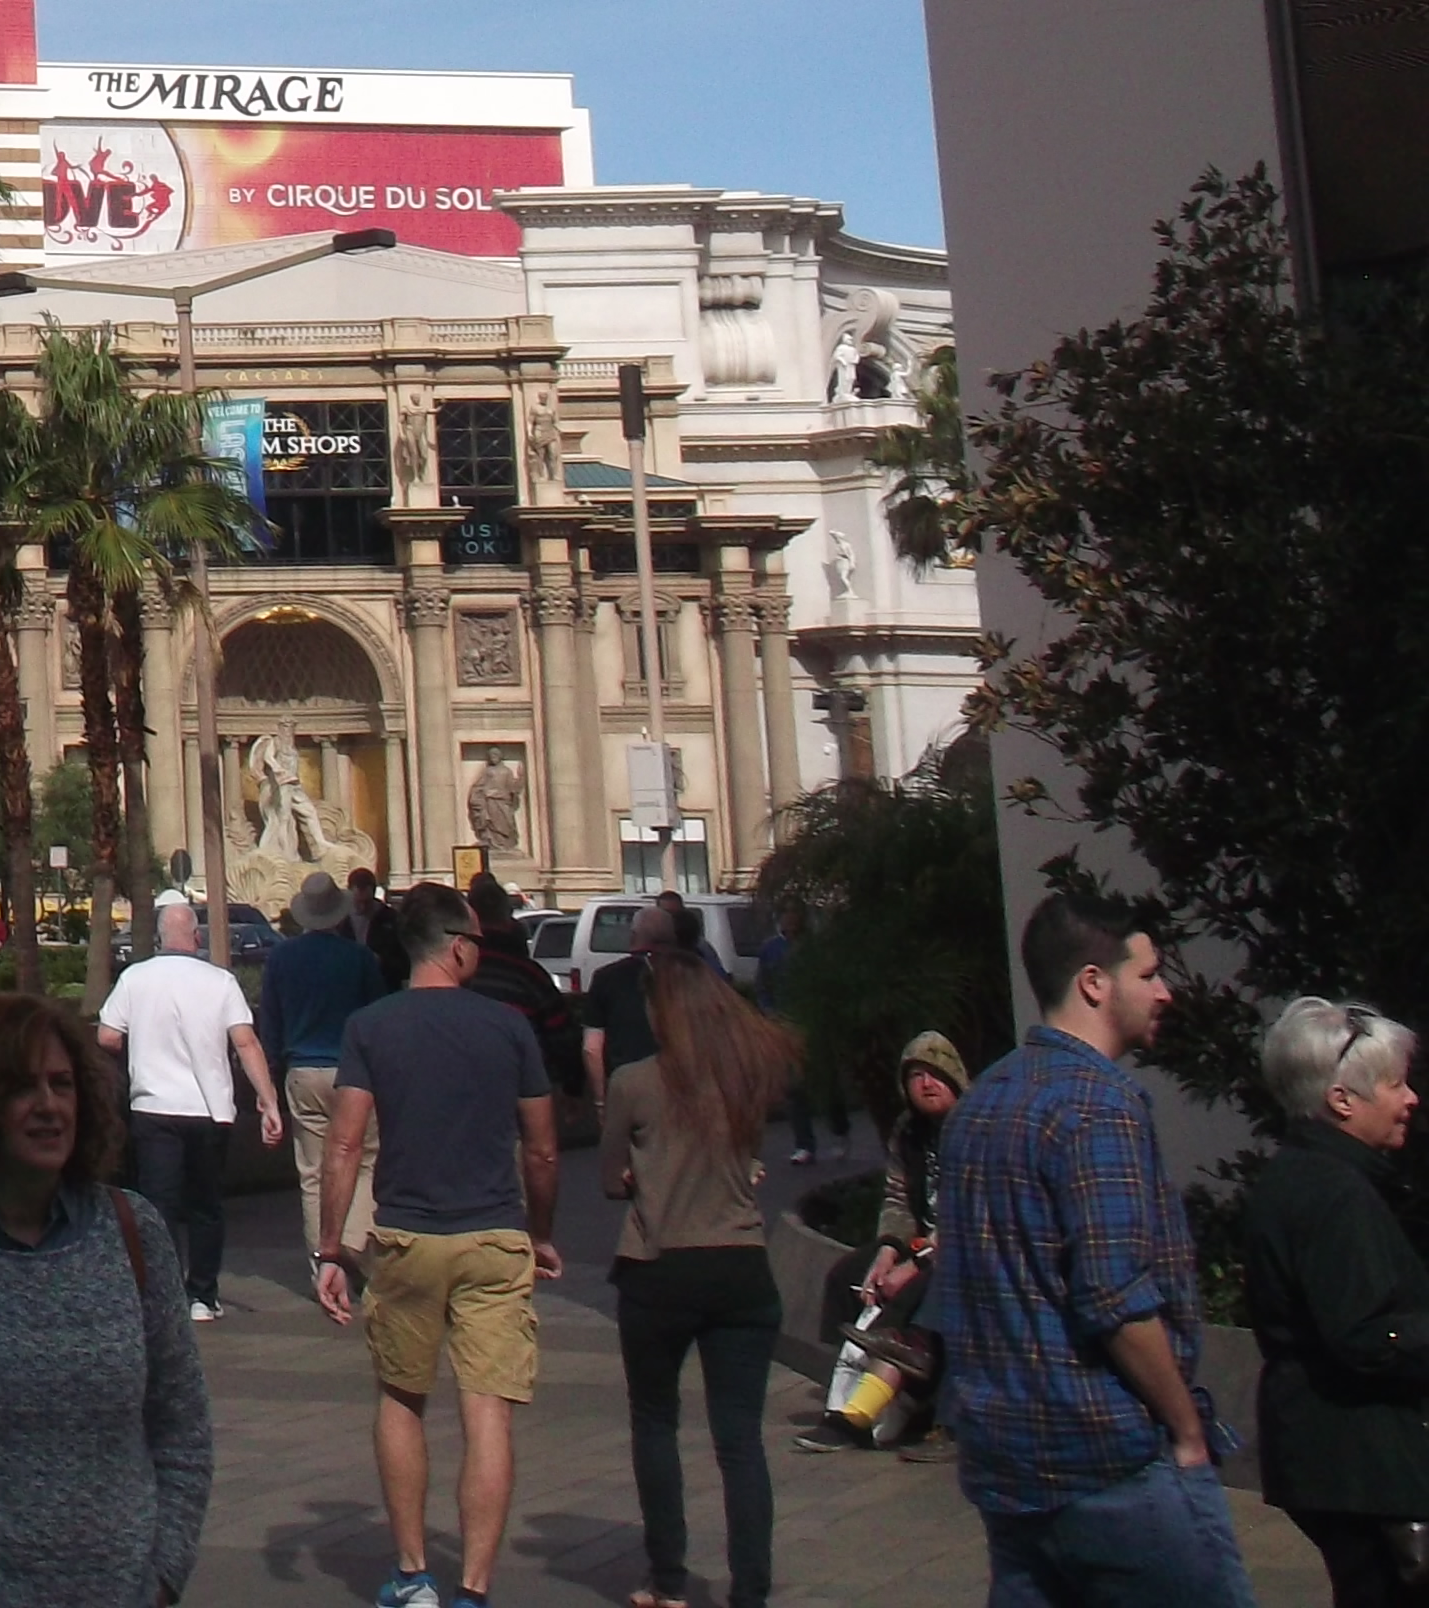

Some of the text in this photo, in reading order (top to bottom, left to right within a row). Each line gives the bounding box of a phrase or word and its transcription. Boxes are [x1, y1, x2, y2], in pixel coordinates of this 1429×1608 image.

[88, 71, 344, 117] THE MIRAGE
[228, 184, 516, 216] BY CIRQUE DU SOL
[224, 370, 324, 382] CAESARS
[264, 418, 297, 433] THE
[287, 435, 361, 454] SHOPS
